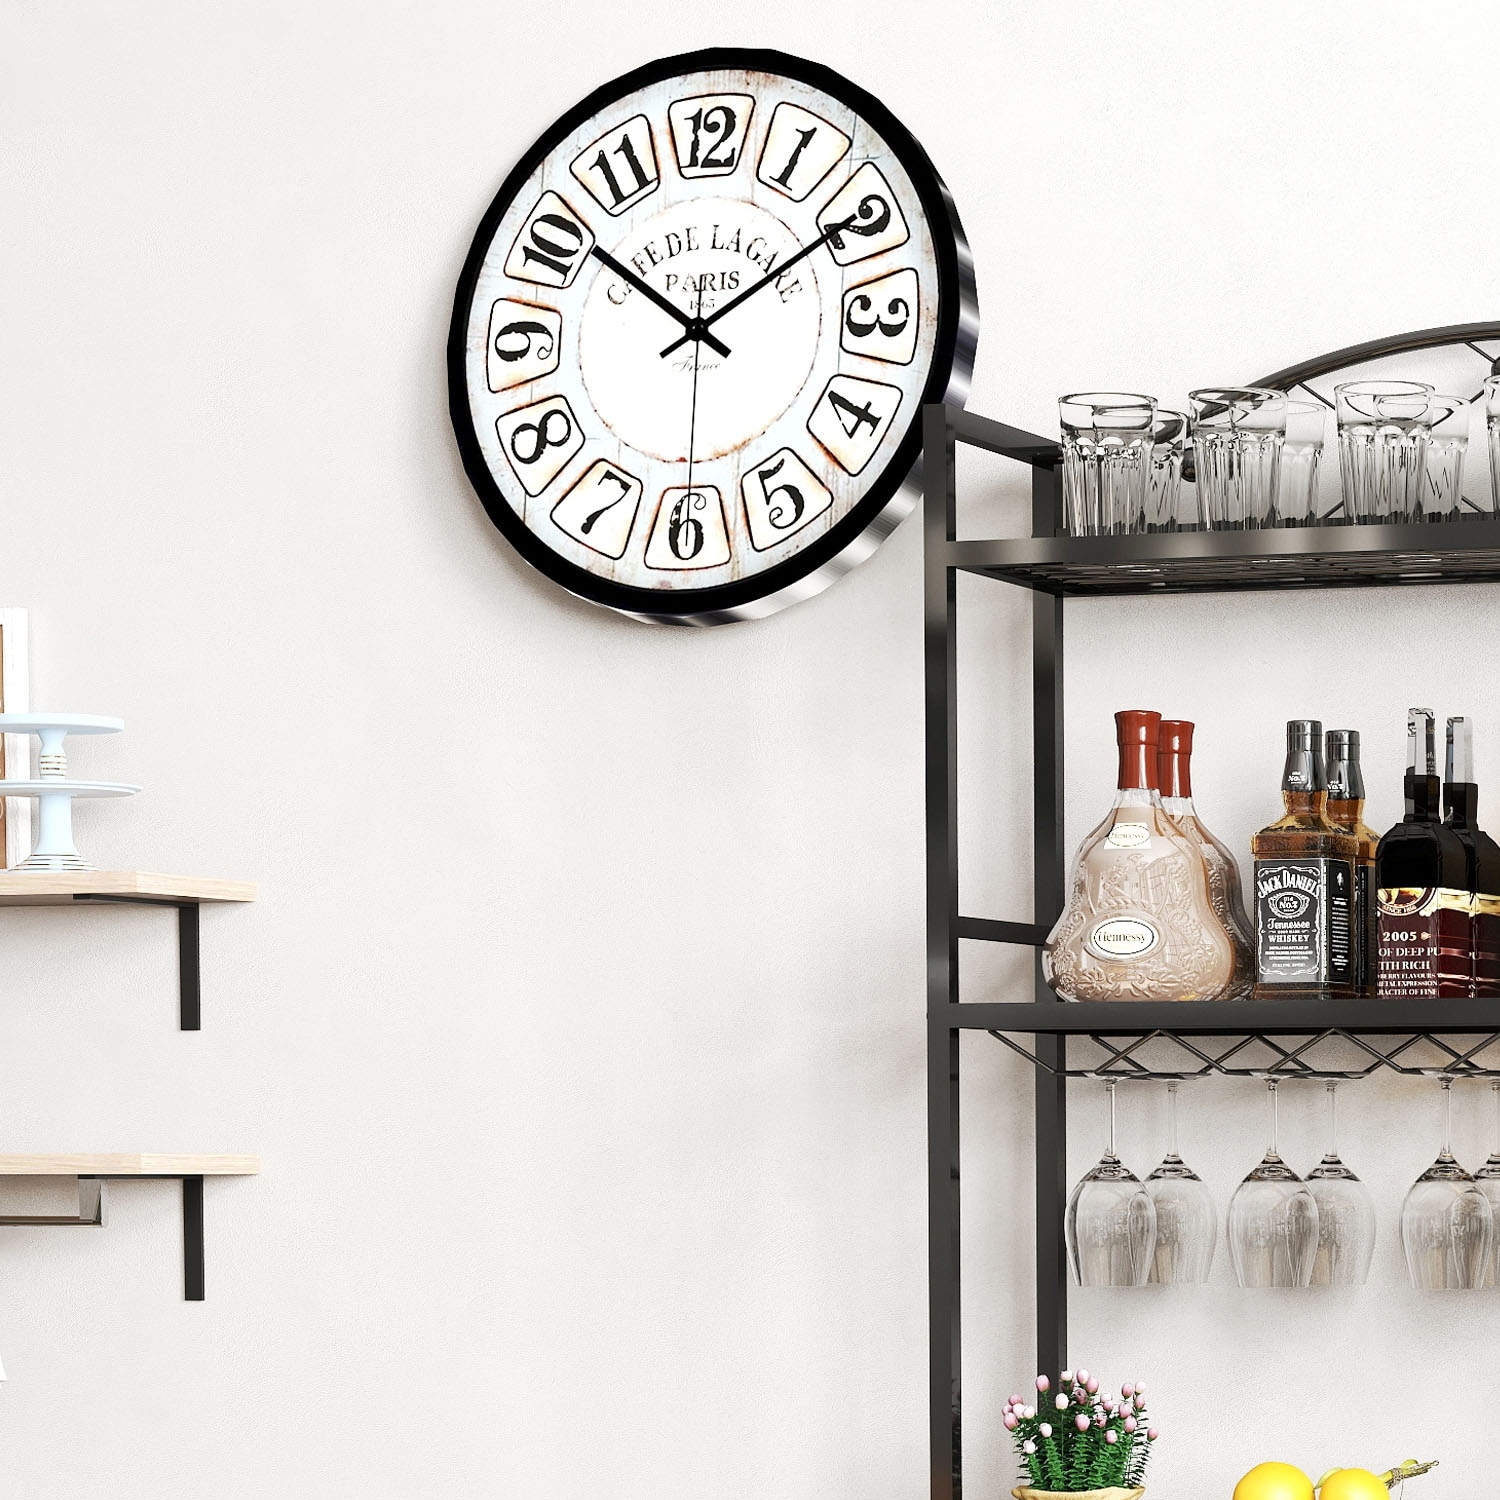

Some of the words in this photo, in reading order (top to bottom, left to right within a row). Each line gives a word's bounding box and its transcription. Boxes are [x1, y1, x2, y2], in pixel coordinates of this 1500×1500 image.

[684, 105, 737, 170] 12
[768, 126, 818, 193] 1
[588, 133, 653, 210] 11
[824, 193, 891, 251] 2
[521, 212, 584, 286] 10
[665, 270, 740, 293] PARIS
[845, 293, 910, 339] 3
[494, 321, 555, 363] 9
[510, 407, 572, 465] 8
[826, 389, 883, 439] 4
[581, 468, 630, 534] 7
[760, 458, 805, 529] 5
[667, 491, 708, 561] 6
[1257, 874, 1283, 899] JACK
[1098, 931, 1146, 944] Hennessy
[1268, 934, 1310, 943] WHISKEY
[1378, 947, 1394, 957] OF
[1395, 947, 1425, 957] DEEP
[1382, 931, 1418, 942] 2005
[1402, 960, 1430, 970] RICH
